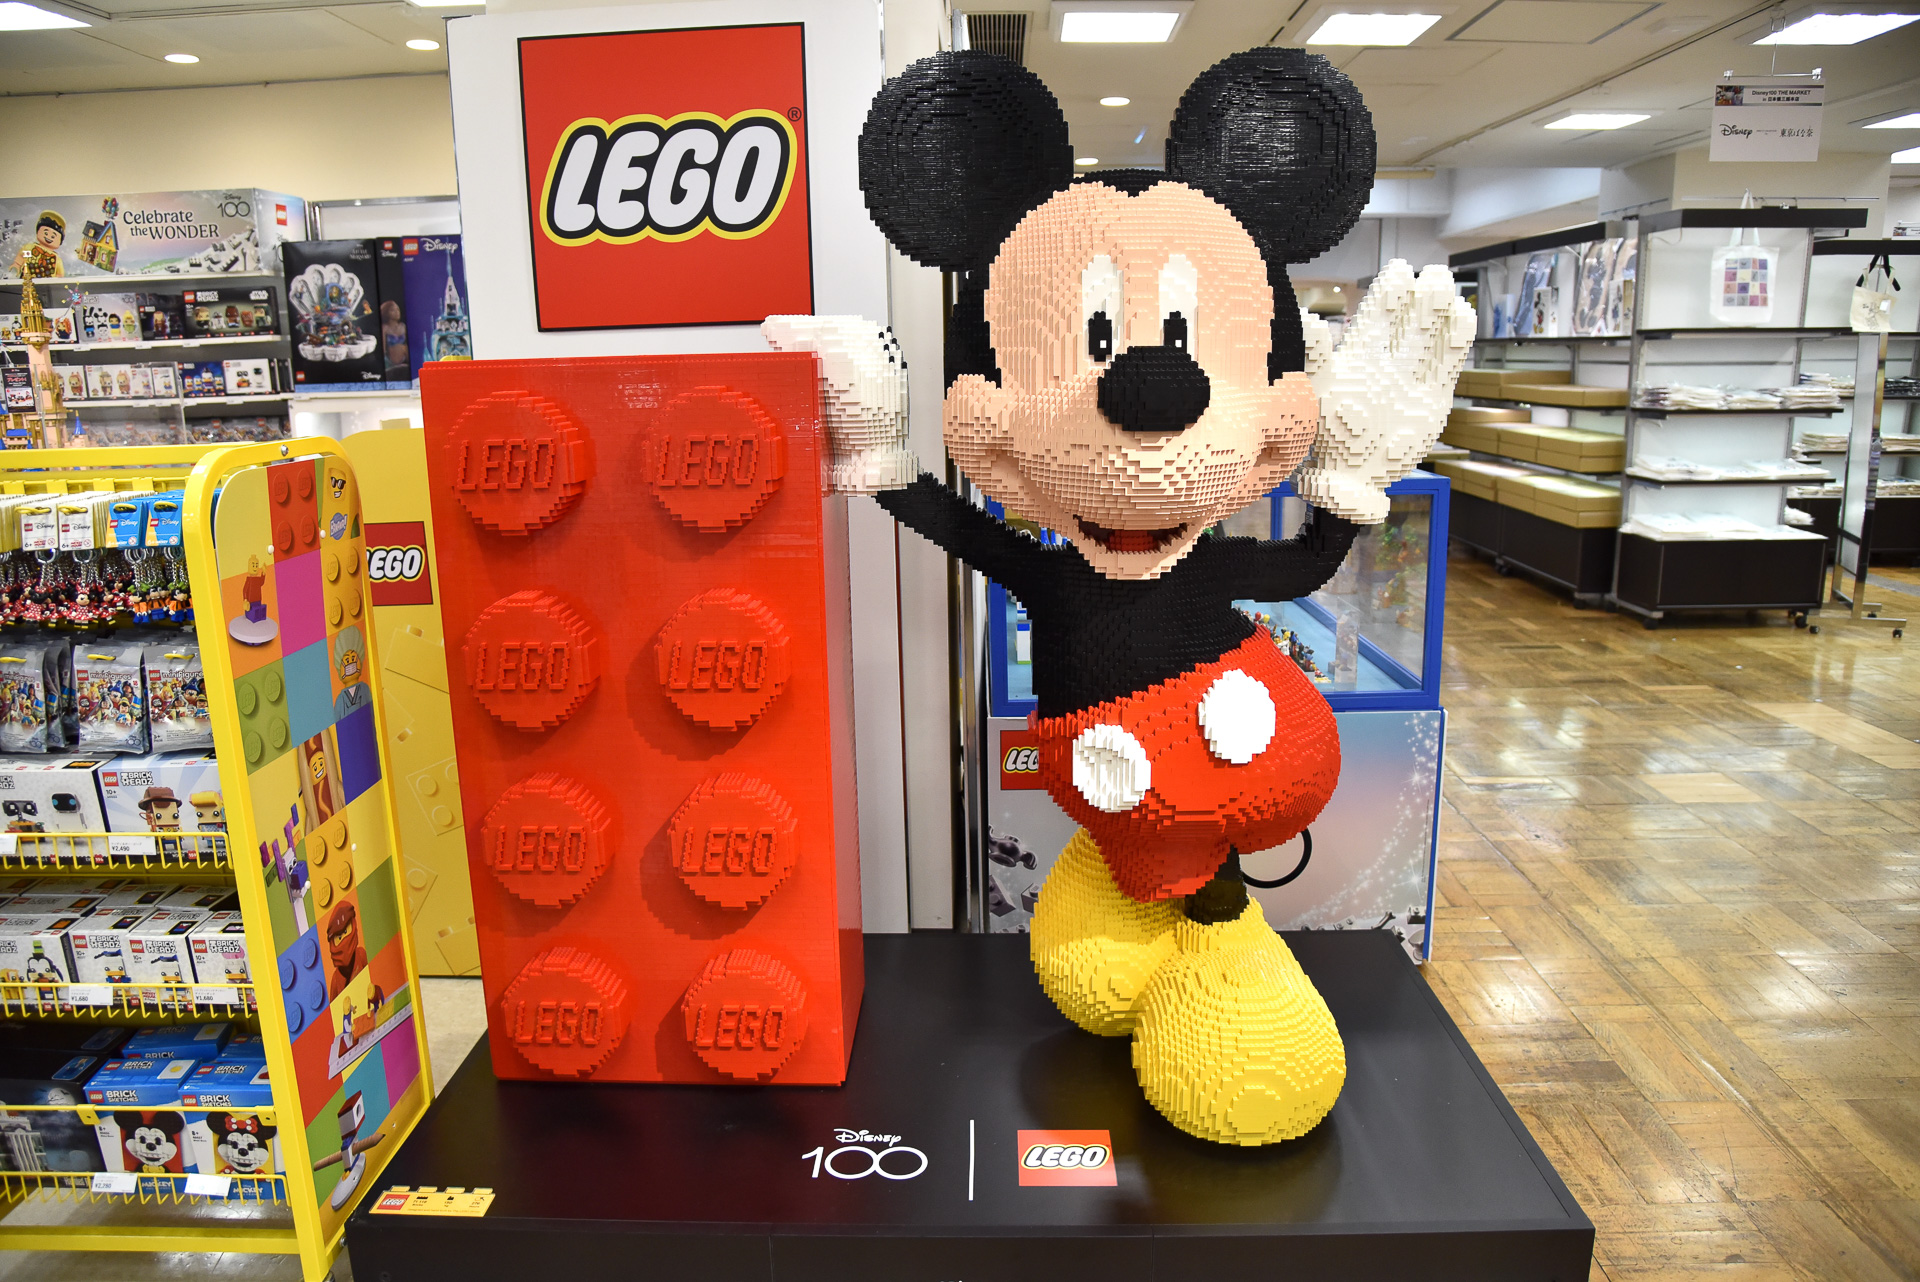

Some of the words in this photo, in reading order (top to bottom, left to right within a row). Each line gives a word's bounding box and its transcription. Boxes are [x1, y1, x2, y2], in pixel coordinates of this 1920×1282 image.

[1719, 124, 1752, 139] Disney
[549, 120, 787, 237] LEGO
[123, 209, 193, 224] Celebrate
[217, 201, 250, 217] 100
[130, 225, 148, 237] the
[148, 224, 219, 240] WONDER
[420, 238, 458, 254] Disney
[361, 371, 381, 380] Disney
[457, 437, 555, 491] LEGO
[656, 433, 759, 487] LEGO
[160, 518, 179, 526] Disney
[366, 548, 422, 580] EGO
[161, 669, 204, 680] minifigure
[476, 642, 569, 690] LEGO
[669, 640, 768, 690] LEGO
[90, 670, 132, 681] minifigures
[1005, 748, 1039, 771] LEG
[121, 778, 154, 786] HEADZ
[128, 771, 152, 779] BRICK
[495, 825, 588, 872] LEGO
[681, 826, 777, 873] LEGO
[514, 1001, 602, 1045] LEGO
[696, 1004, 788, 1049] LEGO
[106, 1090, 137, 1098] BRICK
[200, 1095, 230, 1103] BRICK
[834, 1128, 902, 1147] Disney
[802, 1145, 928, 1180] 100
[1024, 1146, 1108, 1168] LEGO
